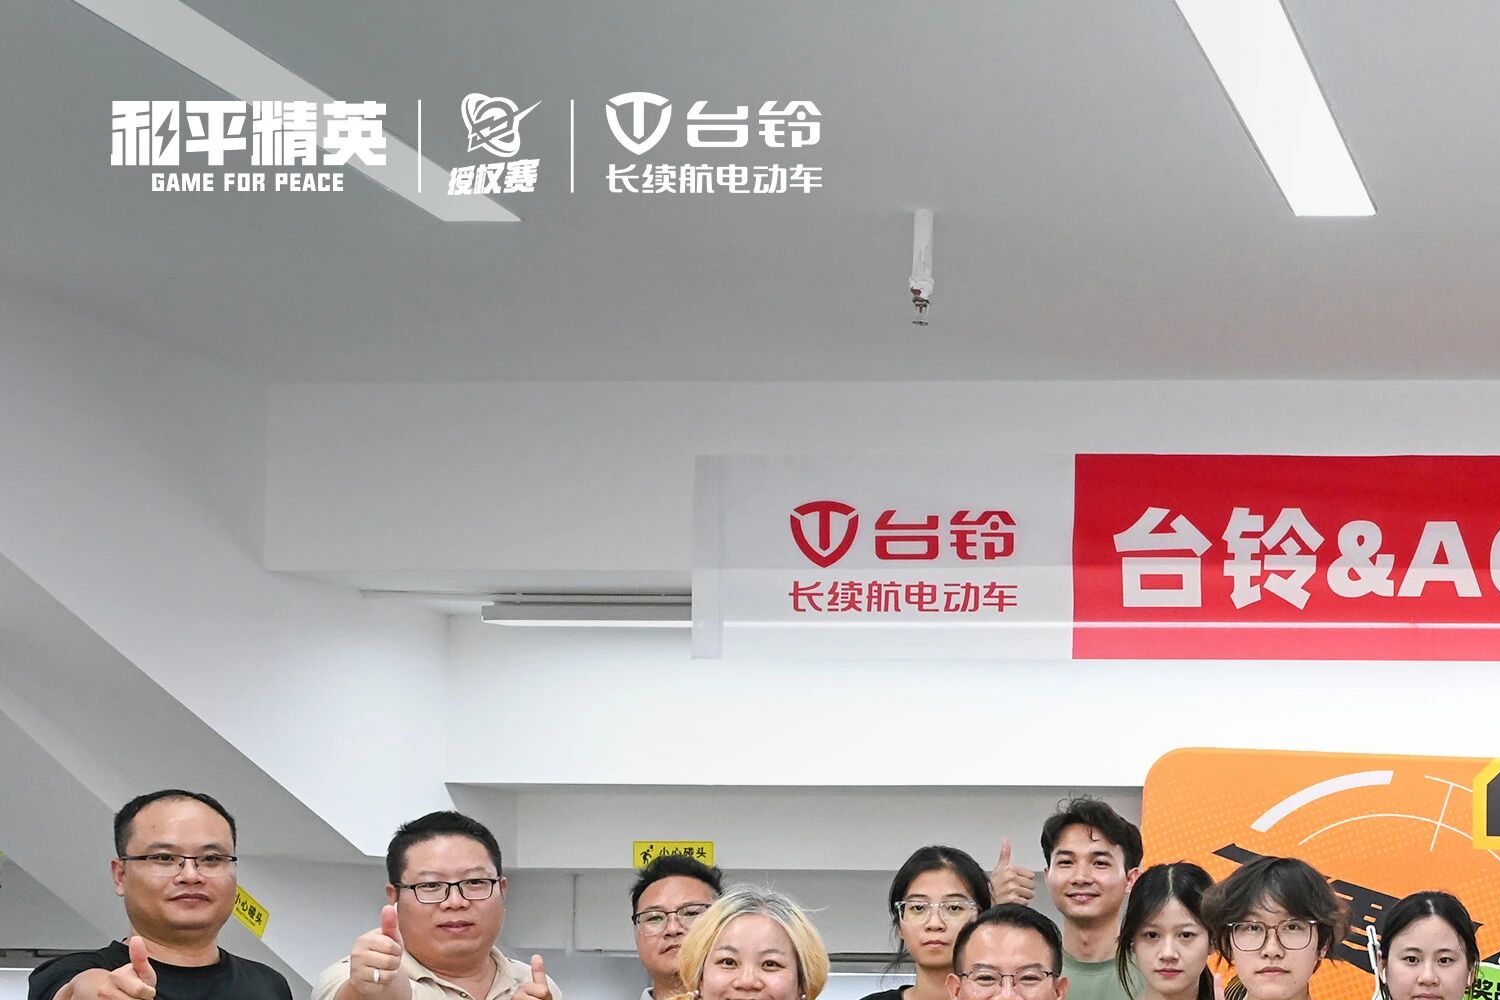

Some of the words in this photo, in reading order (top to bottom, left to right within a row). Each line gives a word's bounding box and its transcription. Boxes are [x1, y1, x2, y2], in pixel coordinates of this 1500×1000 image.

[874, 510, 1016, 561] 台铃
[788, 580, 1018, 613] 长续航电动车
